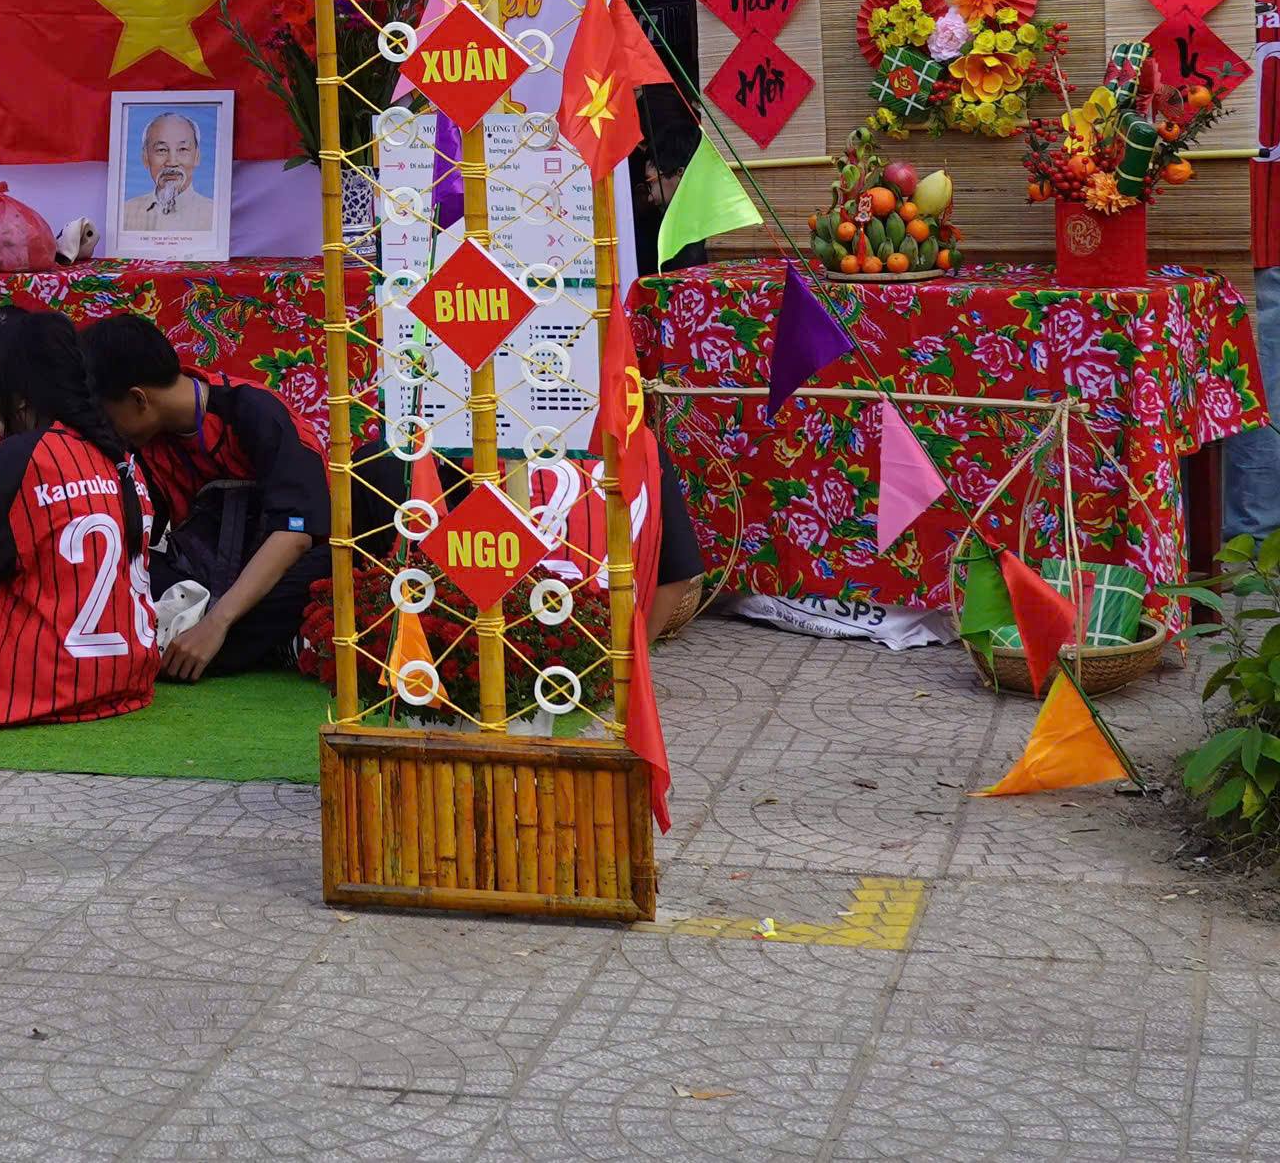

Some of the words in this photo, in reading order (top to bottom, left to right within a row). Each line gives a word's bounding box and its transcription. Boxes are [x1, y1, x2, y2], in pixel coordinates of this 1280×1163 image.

[421, 42, 508, 83] XUÂN
[736, 57, 784, 117] Mới
[434, 282, 509, 322] BÍNH
[34, 475, 118, 508] Kaoruko
[447, 530, 520, 577] NGỌ
